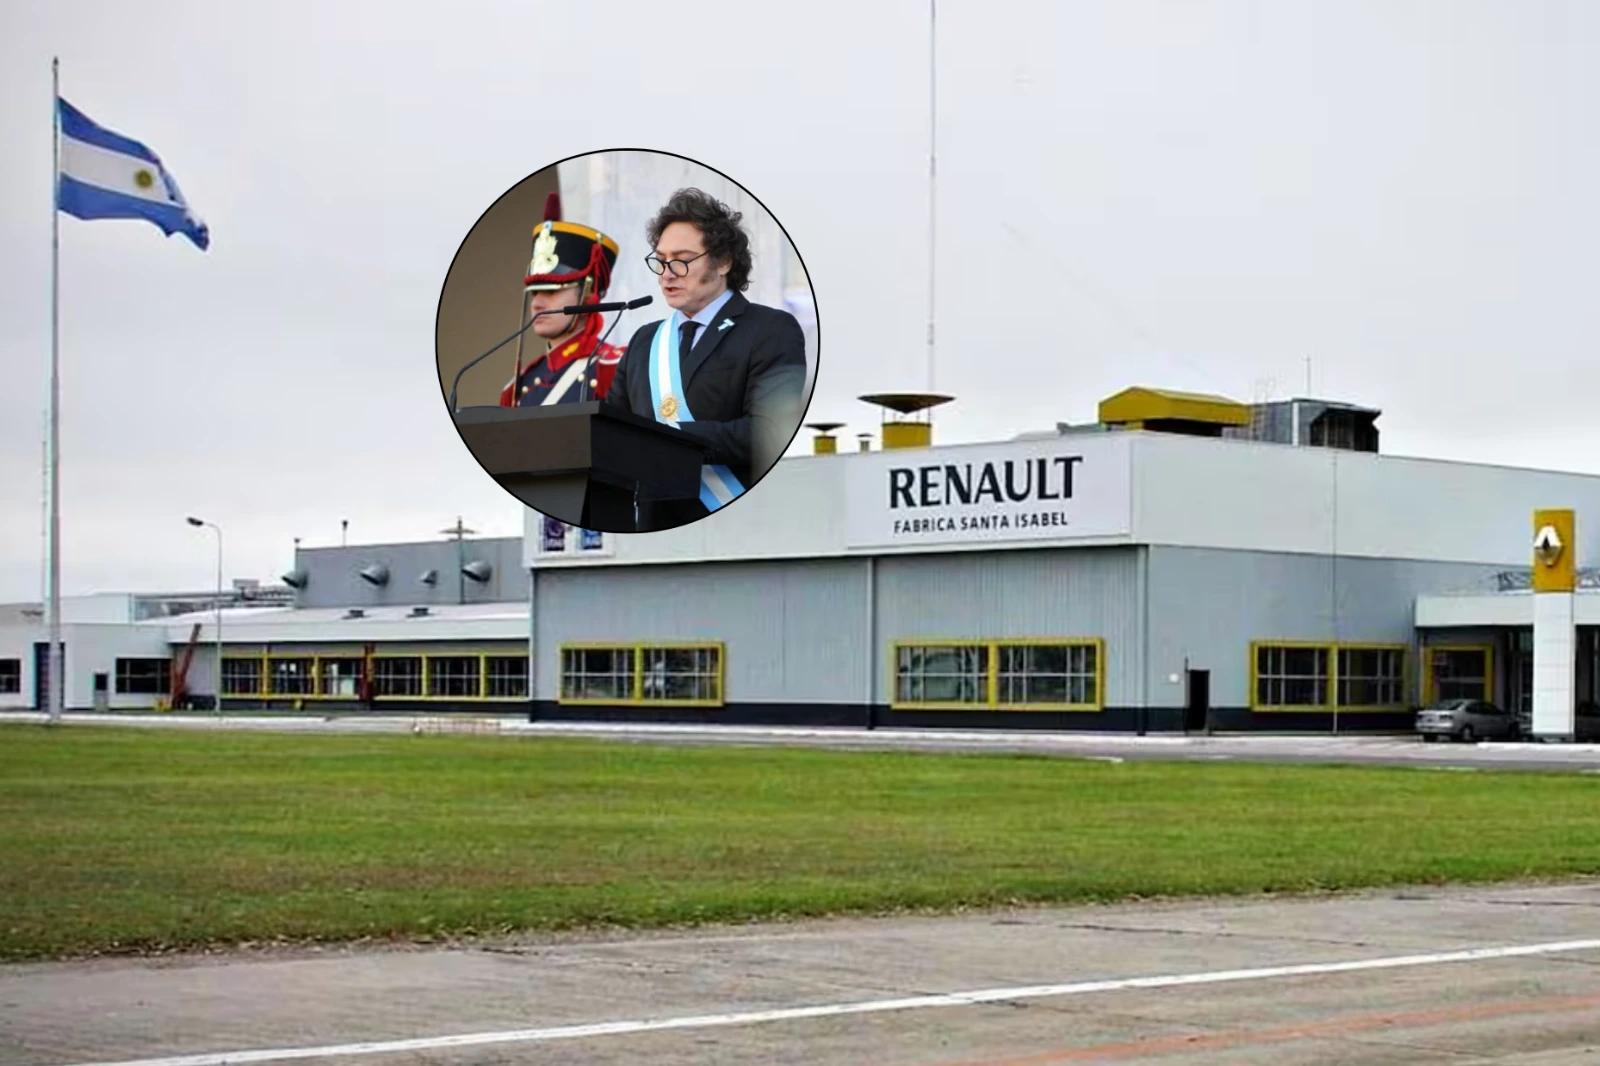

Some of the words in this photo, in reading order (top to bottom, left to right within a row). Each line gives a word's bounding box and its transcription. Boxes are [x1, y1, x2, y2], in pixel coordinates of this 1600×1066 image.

[889, 456, 1083, 509] RENAULT
[893, 517, 956, 534] FABRICA
[960, 514, 1010, 531] SANTA
[1015, 512, 1068, 528] ISABEL
